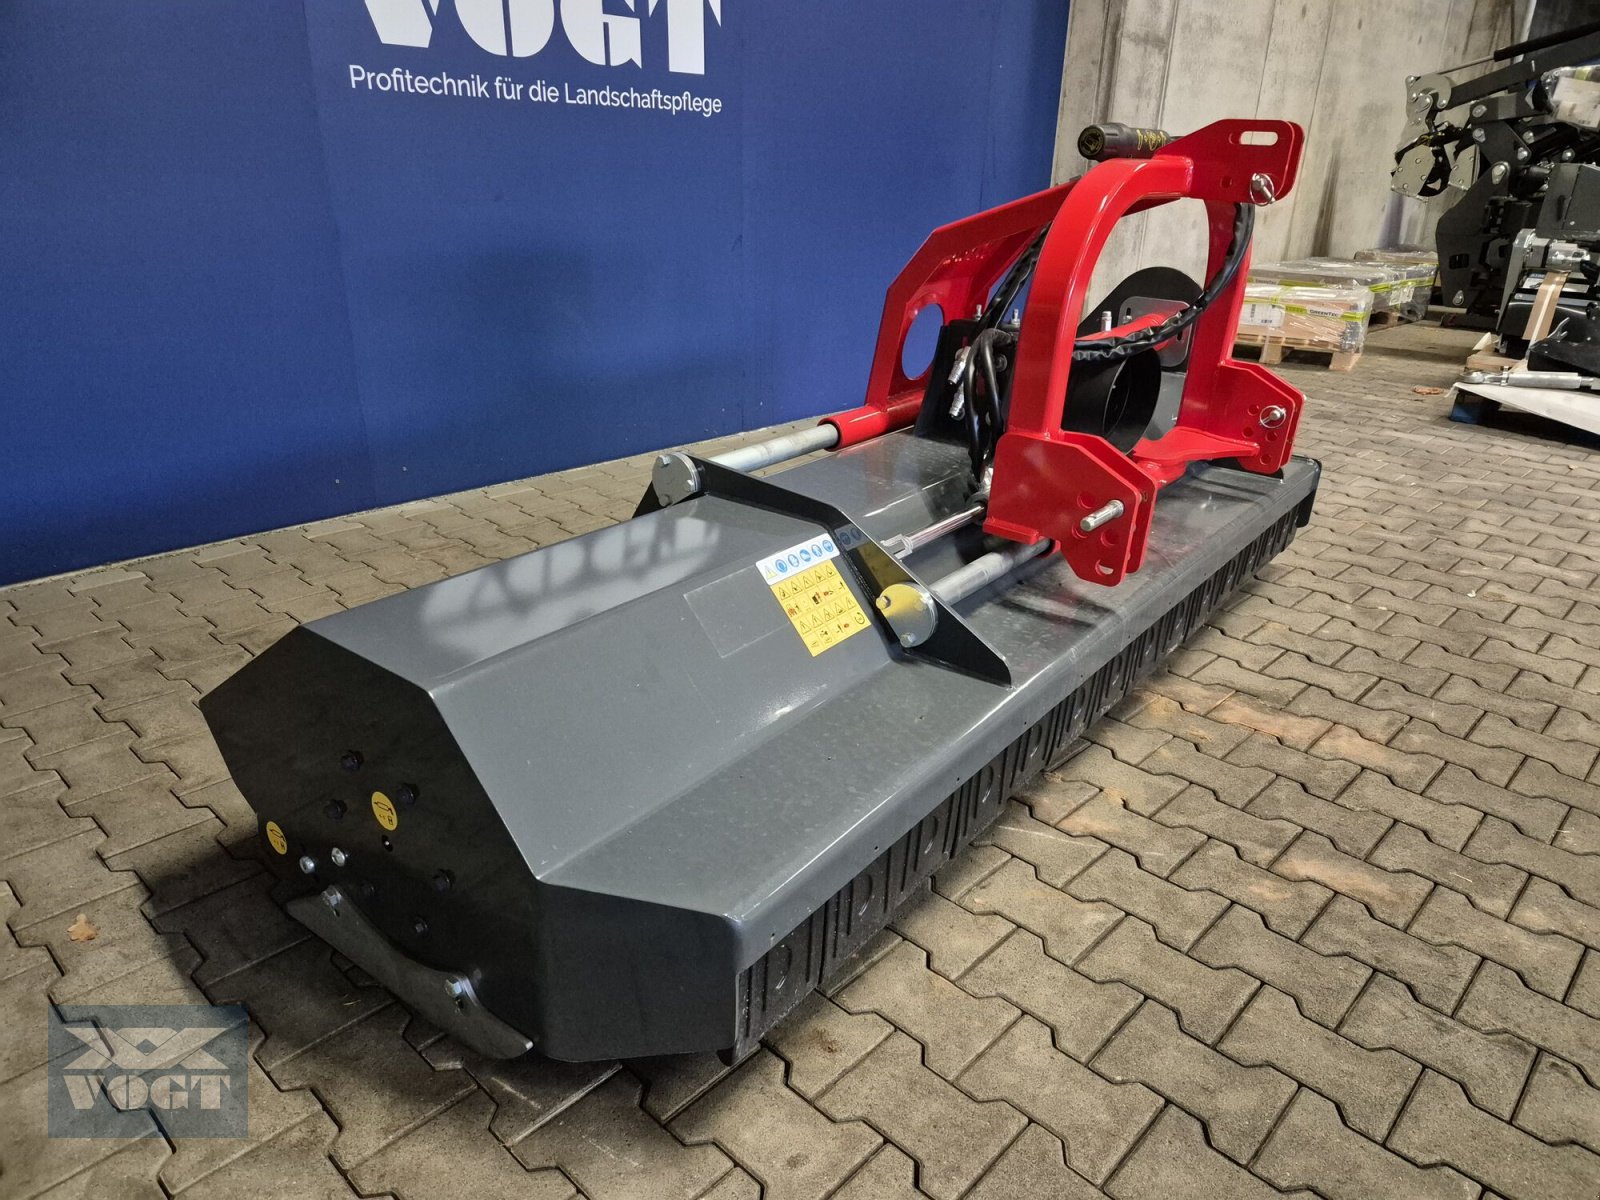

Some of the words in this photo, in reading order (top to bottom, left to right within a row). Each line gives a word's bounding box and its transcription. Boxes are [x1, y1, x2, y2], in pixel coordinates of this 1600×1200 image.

[349, 64, 490, 99] Profitechnik
[494, 76, 524, 100] für
[529, 80, 559, 103] die
[565, 82, 722, 117] Landschaftspflege
